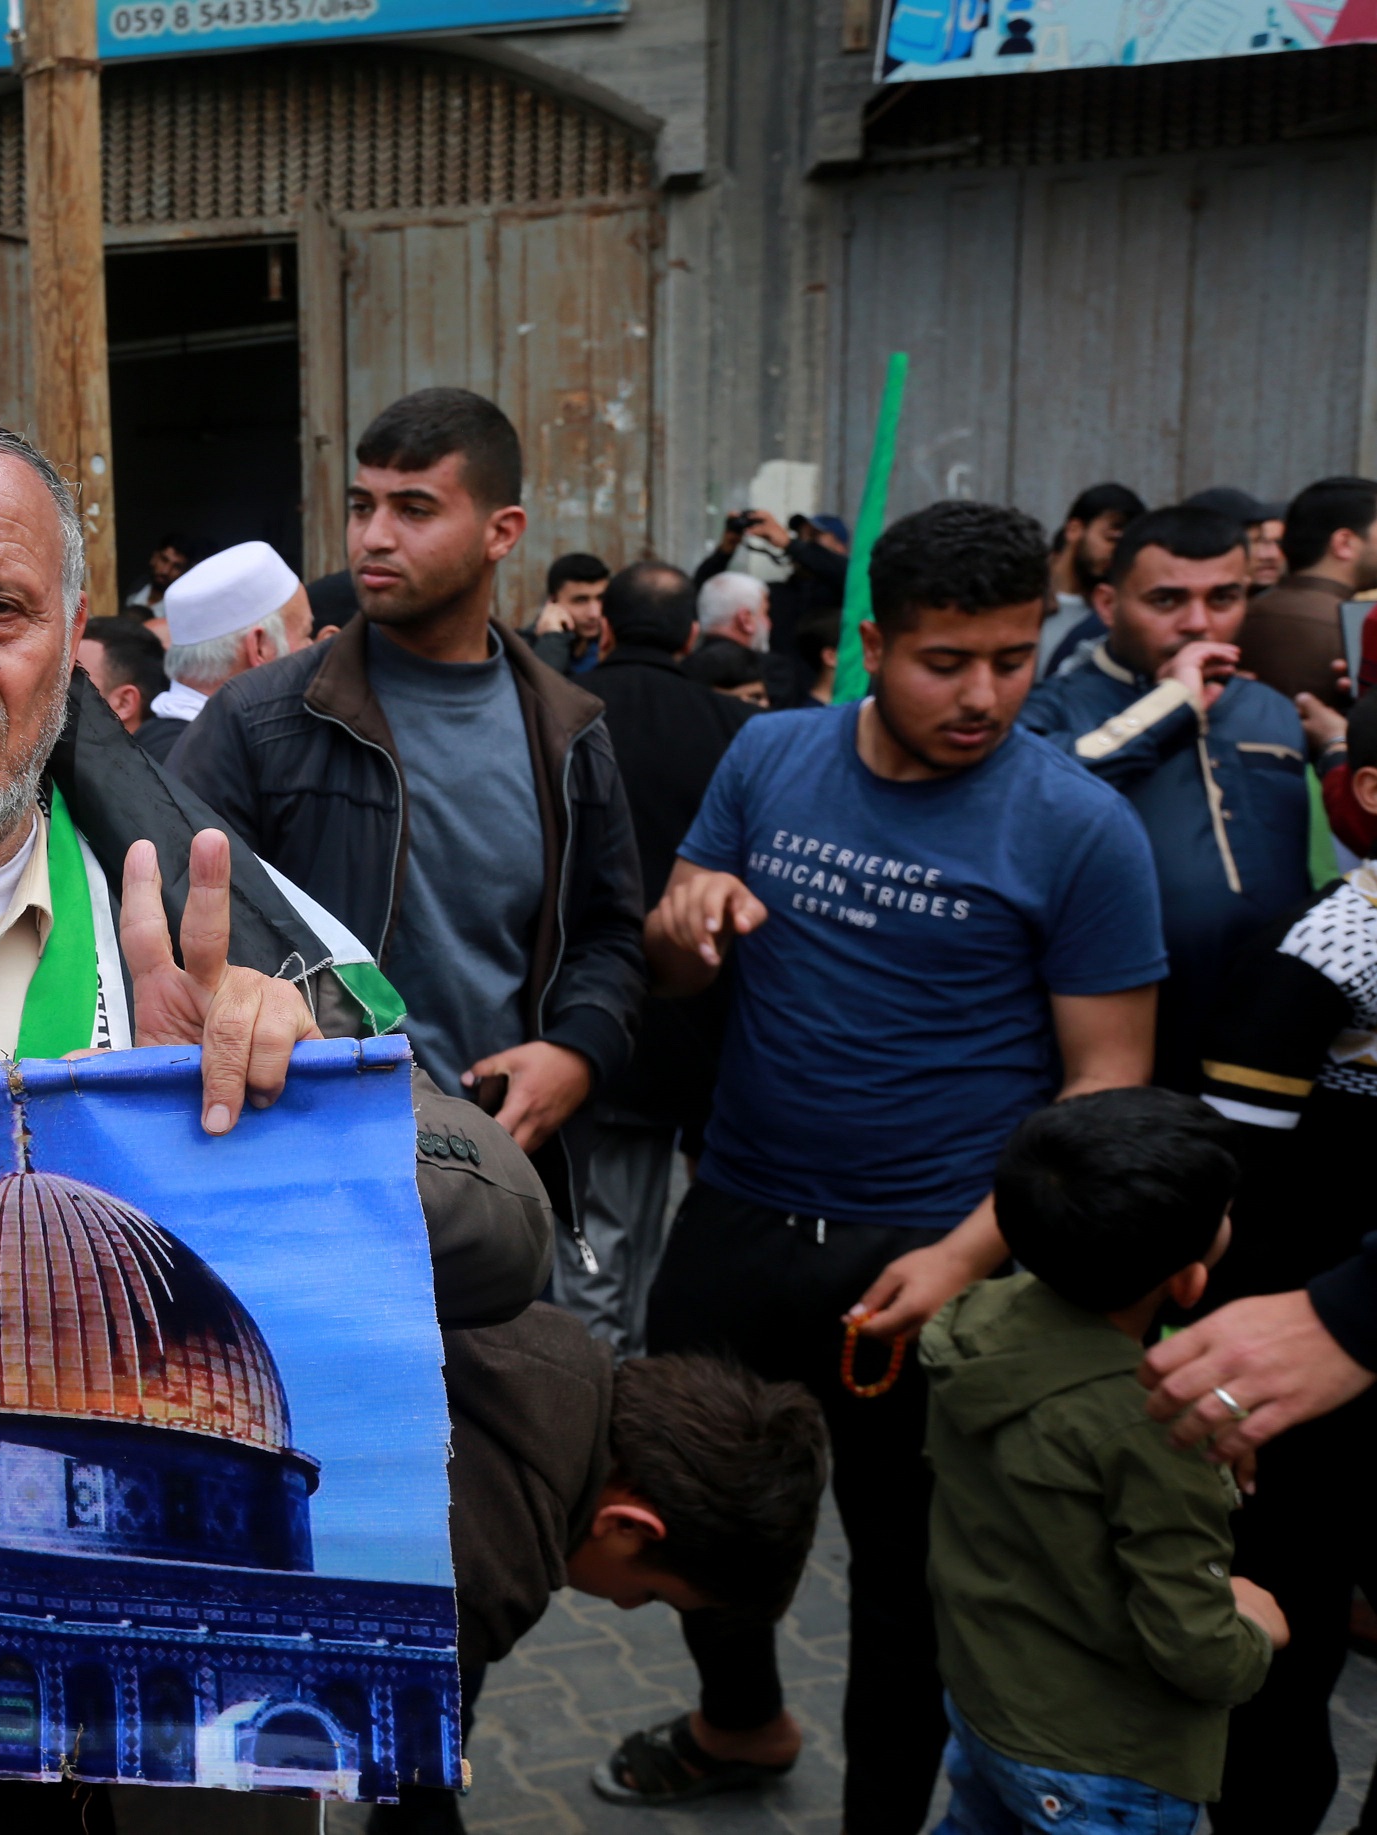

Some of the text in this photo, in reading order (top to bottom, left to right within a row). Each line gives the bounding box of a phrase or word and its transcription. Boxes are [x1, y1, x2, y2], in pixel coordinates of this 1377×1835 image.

[114, 7, 165, 35] 059
[173, 5, 190, 28] 8
[747, 852, 971, 921] AFRICAN TRIBES
[772, 829, 943, 888] EXPERIENCE
